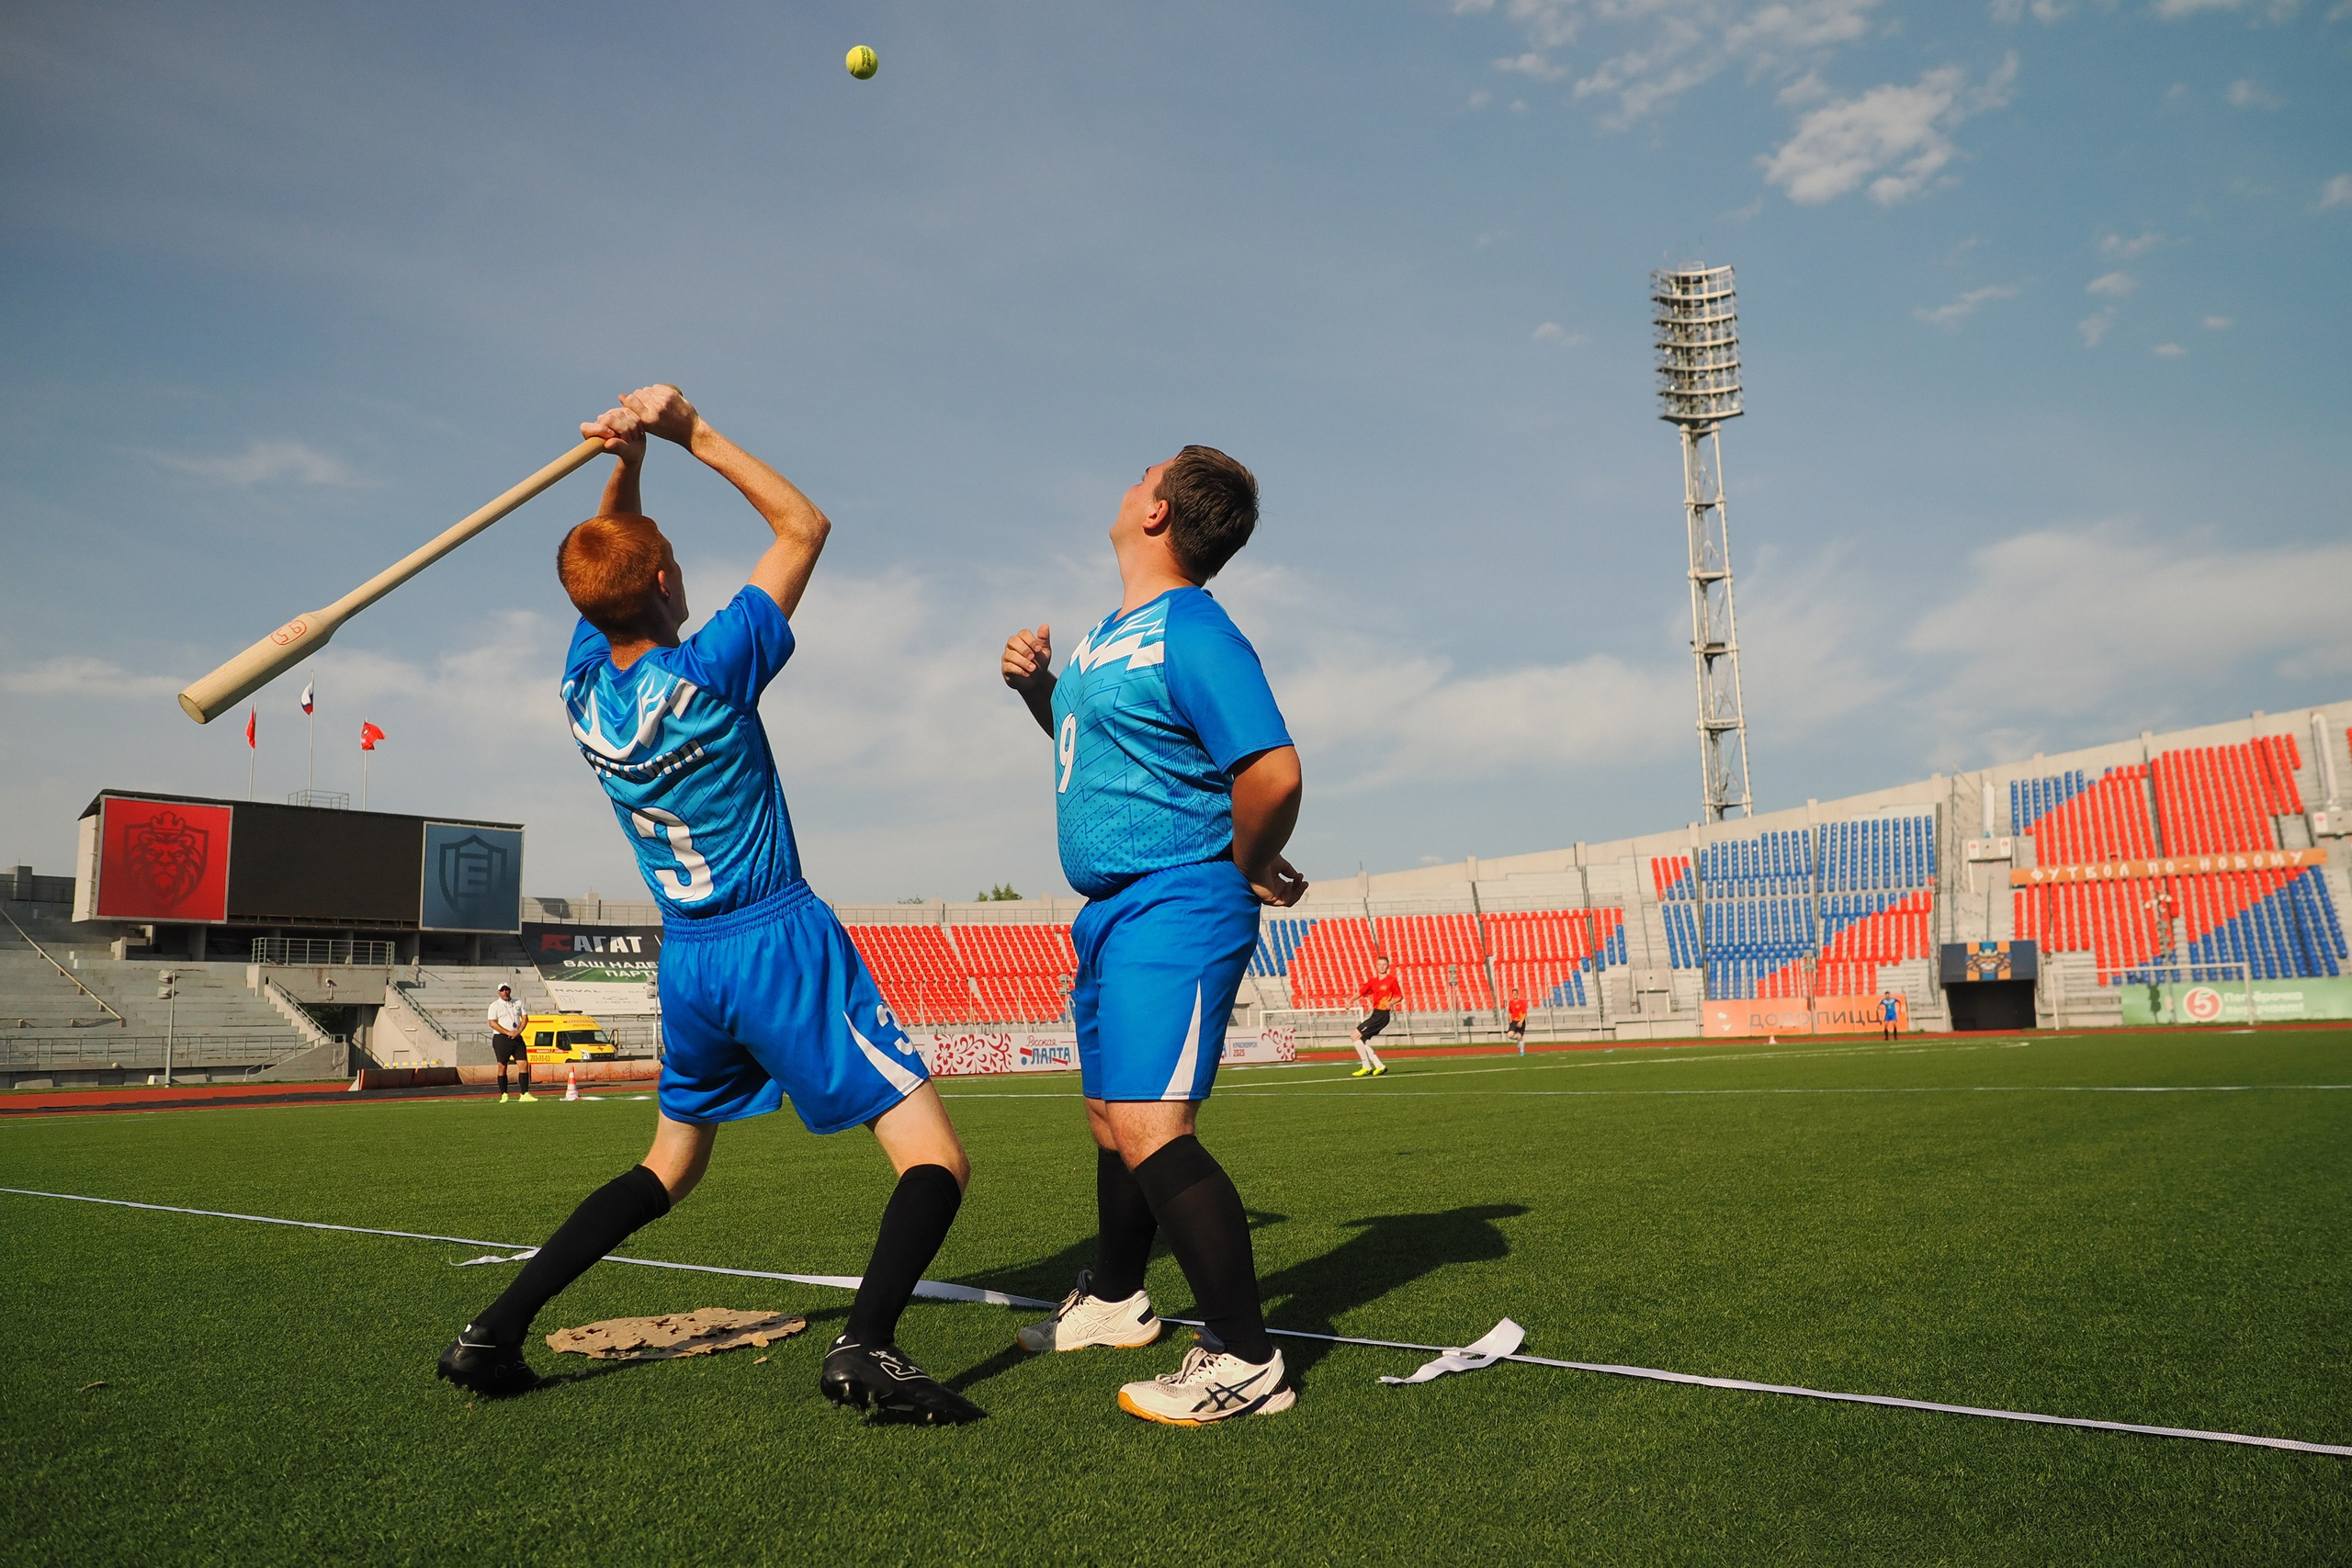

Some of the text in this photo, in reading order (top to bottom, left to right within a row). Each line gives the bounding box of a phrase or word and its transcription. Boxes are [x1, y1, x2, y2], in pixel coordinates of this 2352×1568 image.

[1057, 712, 1077, 794] 9
[631, 807, 714, 902] 3
[2030, 863, 2130, 881] ФУТБОЛ
[574, 935, 642, 953] АГАТ
[563, 960, 660, 970] ВАШ НАДЕ
[2193, 991, 2212, 1015] 5
[1816, 1009, 1883, 1025] ПИЦЦ
[876, 1001, 915, 1055] 3
[1031, 1047, 1070, 1065] ЛАПТА
